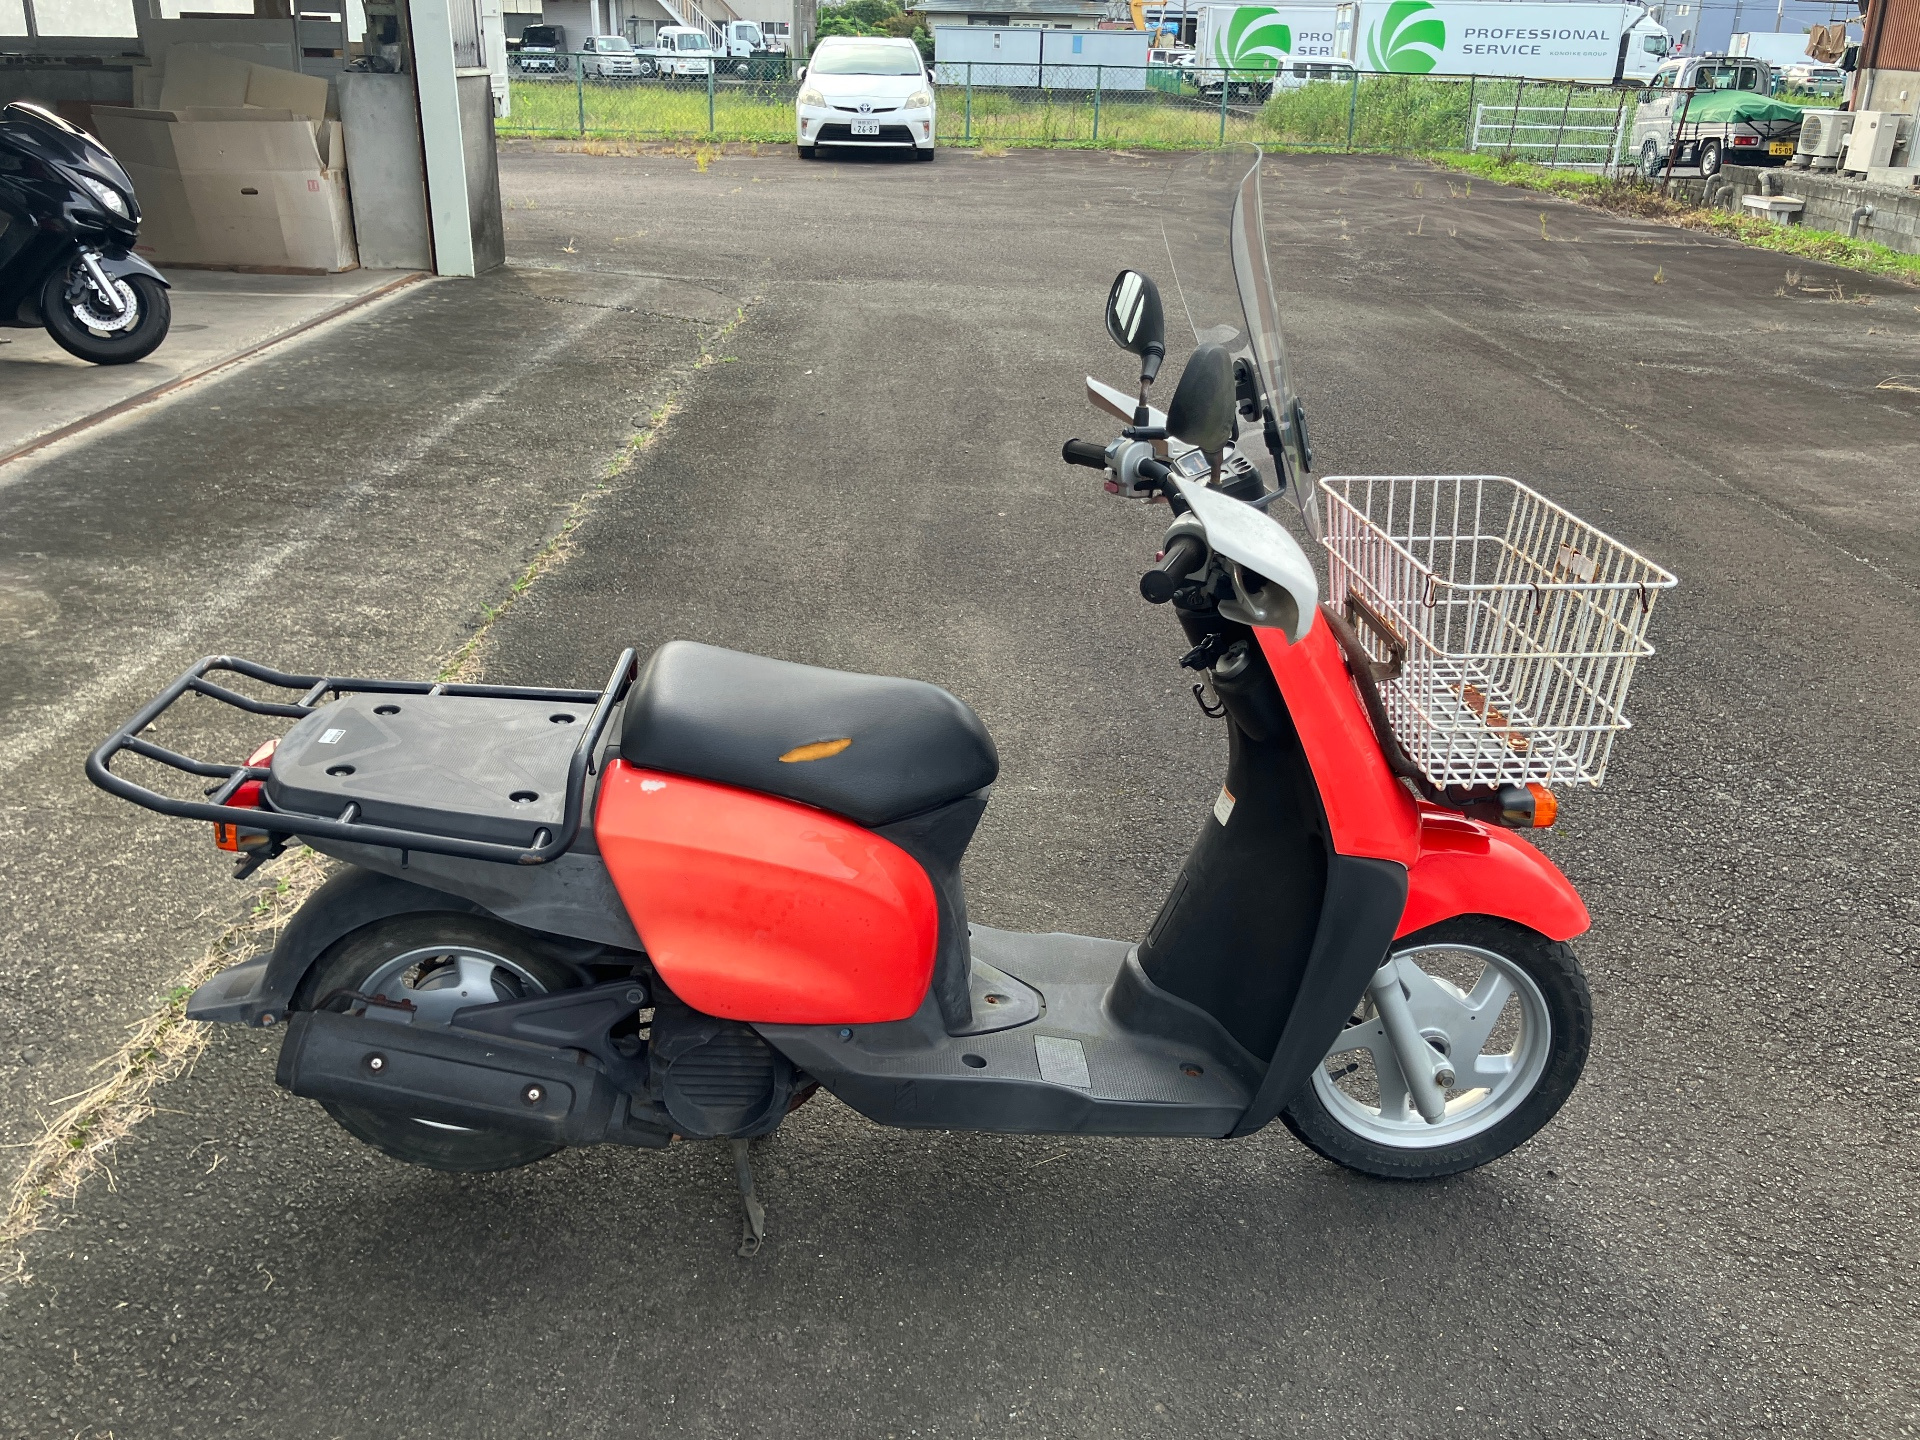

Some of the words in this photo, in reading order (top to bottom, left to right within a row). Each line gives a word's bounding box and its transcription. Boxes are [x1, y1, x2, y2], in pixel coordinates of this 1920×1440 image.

[1464, 28, 1610, 40] PROFESSIONAL
[1298, 46, 1333, 56] SER
[1462, 44, 1541, 55] SERVICE
